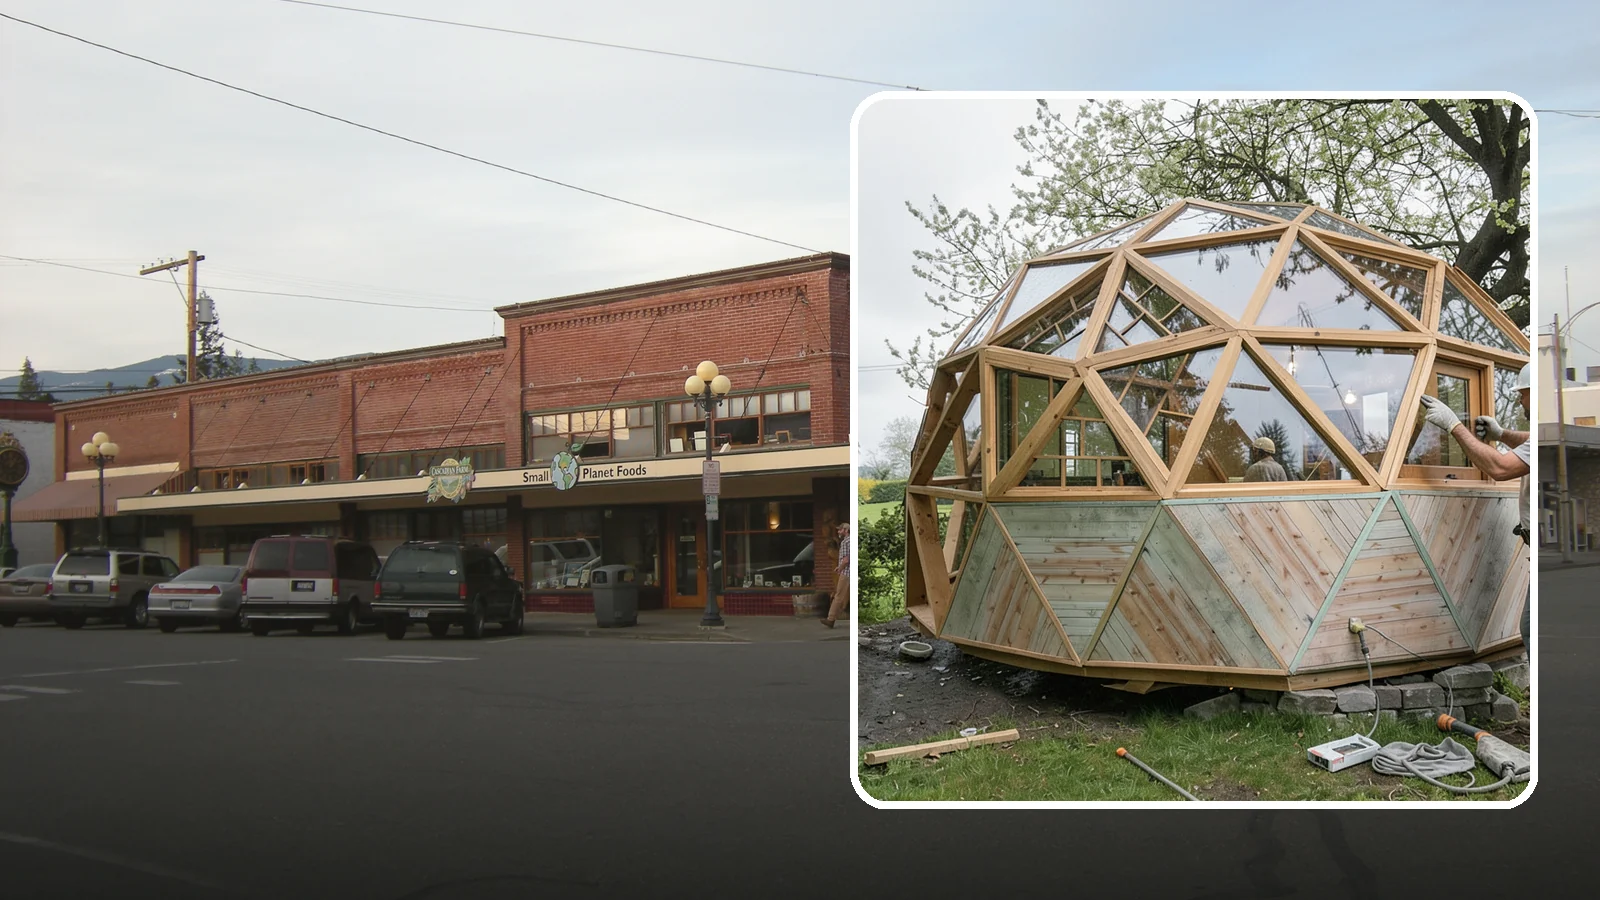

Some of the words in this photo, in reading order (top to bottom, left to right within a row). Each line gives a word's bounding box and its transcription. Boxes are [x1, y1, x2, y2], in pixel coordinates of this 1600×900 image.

[523, 471, 548, 483] Small
[583, 468, 614, 479] Planet
[617, 464, 647, 476] Foods
